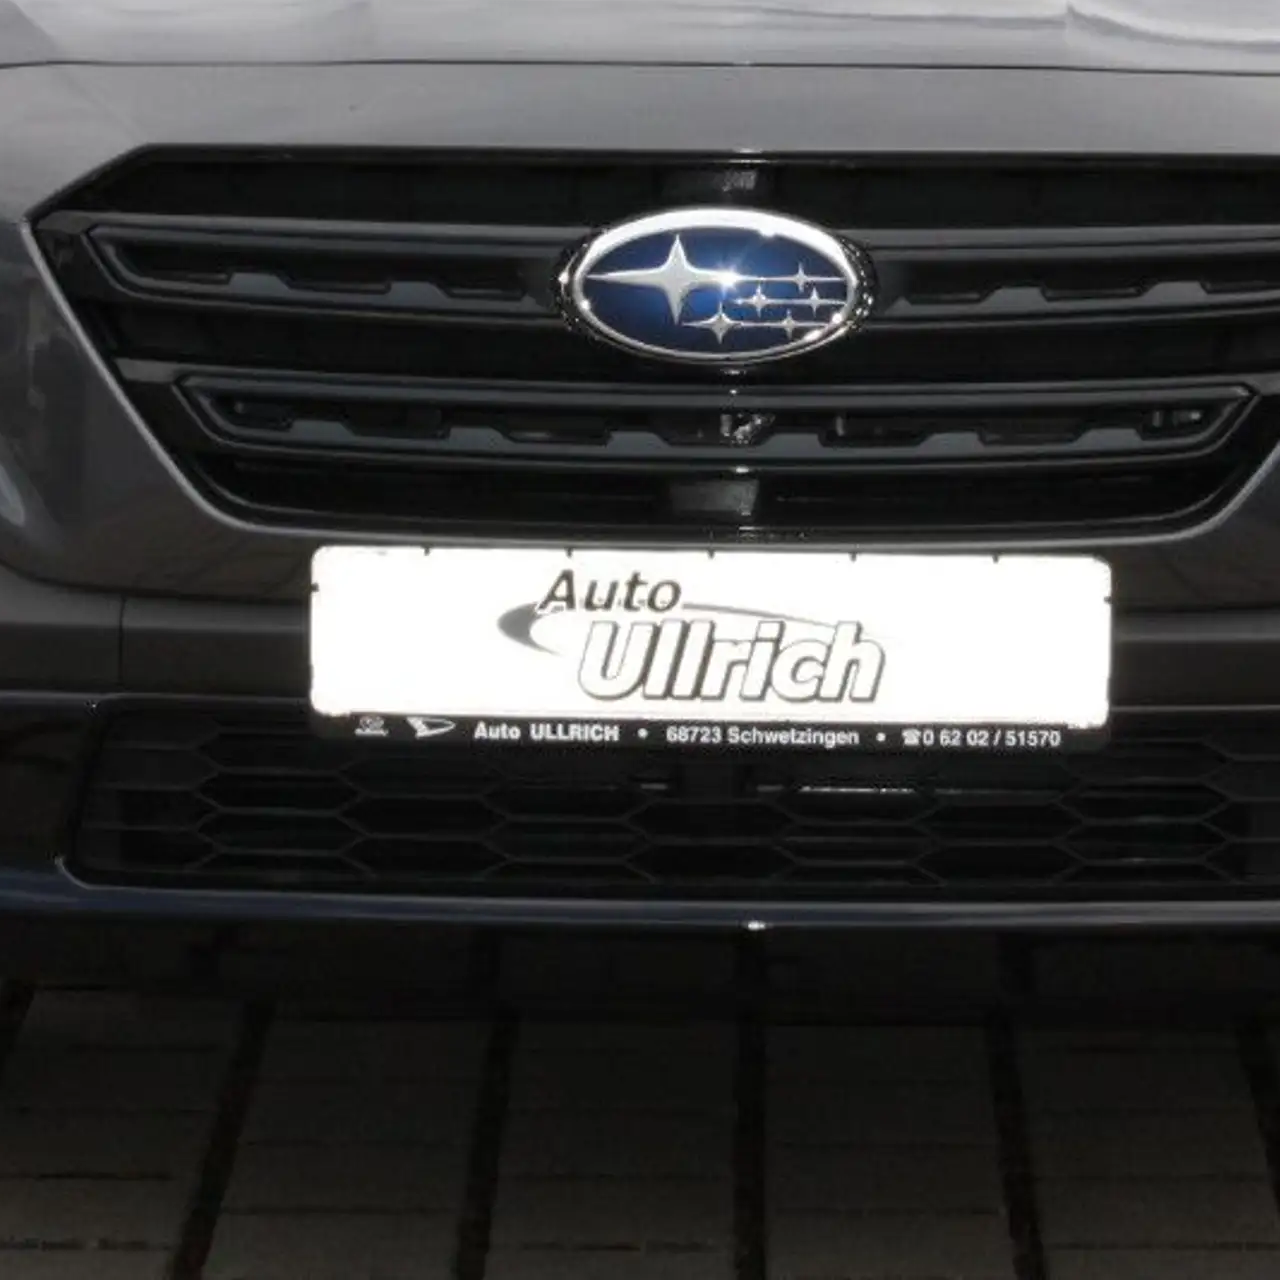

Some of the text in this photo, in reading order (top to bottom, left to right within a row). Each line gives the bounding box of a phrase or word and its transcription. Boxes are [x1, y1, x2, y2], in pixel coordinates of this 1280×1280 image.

[538, 568, 682, 613] Auto
[577, 619, 887, 702] Ullrich
[473, 721, 521, 740] Auto
[530, 722, 620, 742] ULLRICH
[666, 725, 722, 744] 68723
[728, 725, 860, 749] Schwetzingen
